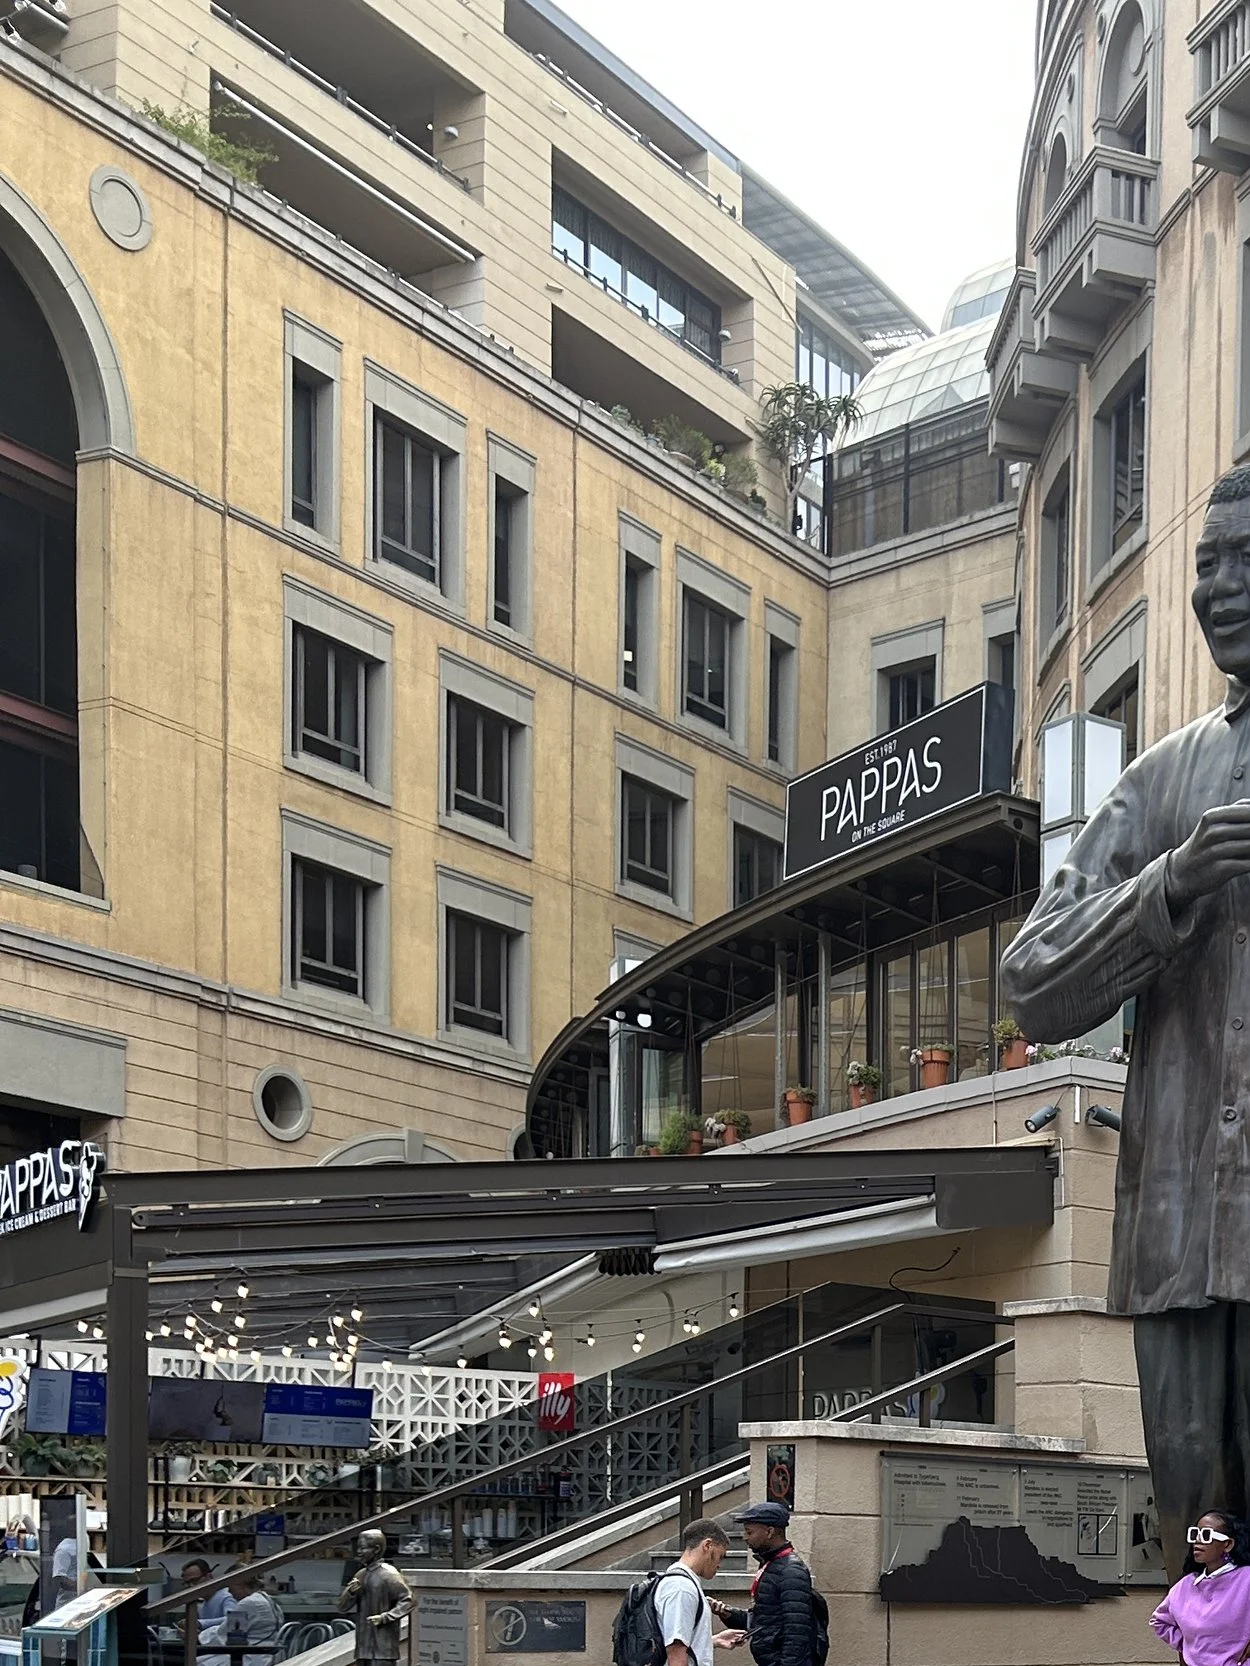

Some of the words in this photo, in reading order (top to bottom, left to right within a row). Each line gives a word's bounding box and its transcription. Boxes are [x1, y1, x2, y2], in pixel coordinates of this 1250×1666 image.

[820, 736, 942, 841] PAPPAS
[852, 829, 862, 843] ON
[863, 822, 877, 838] THE
[877, 809, 906, 832] SQUARE
[0, 1140, 81, 1219] APPAS
[540, 1381, 571, 1425] illy
